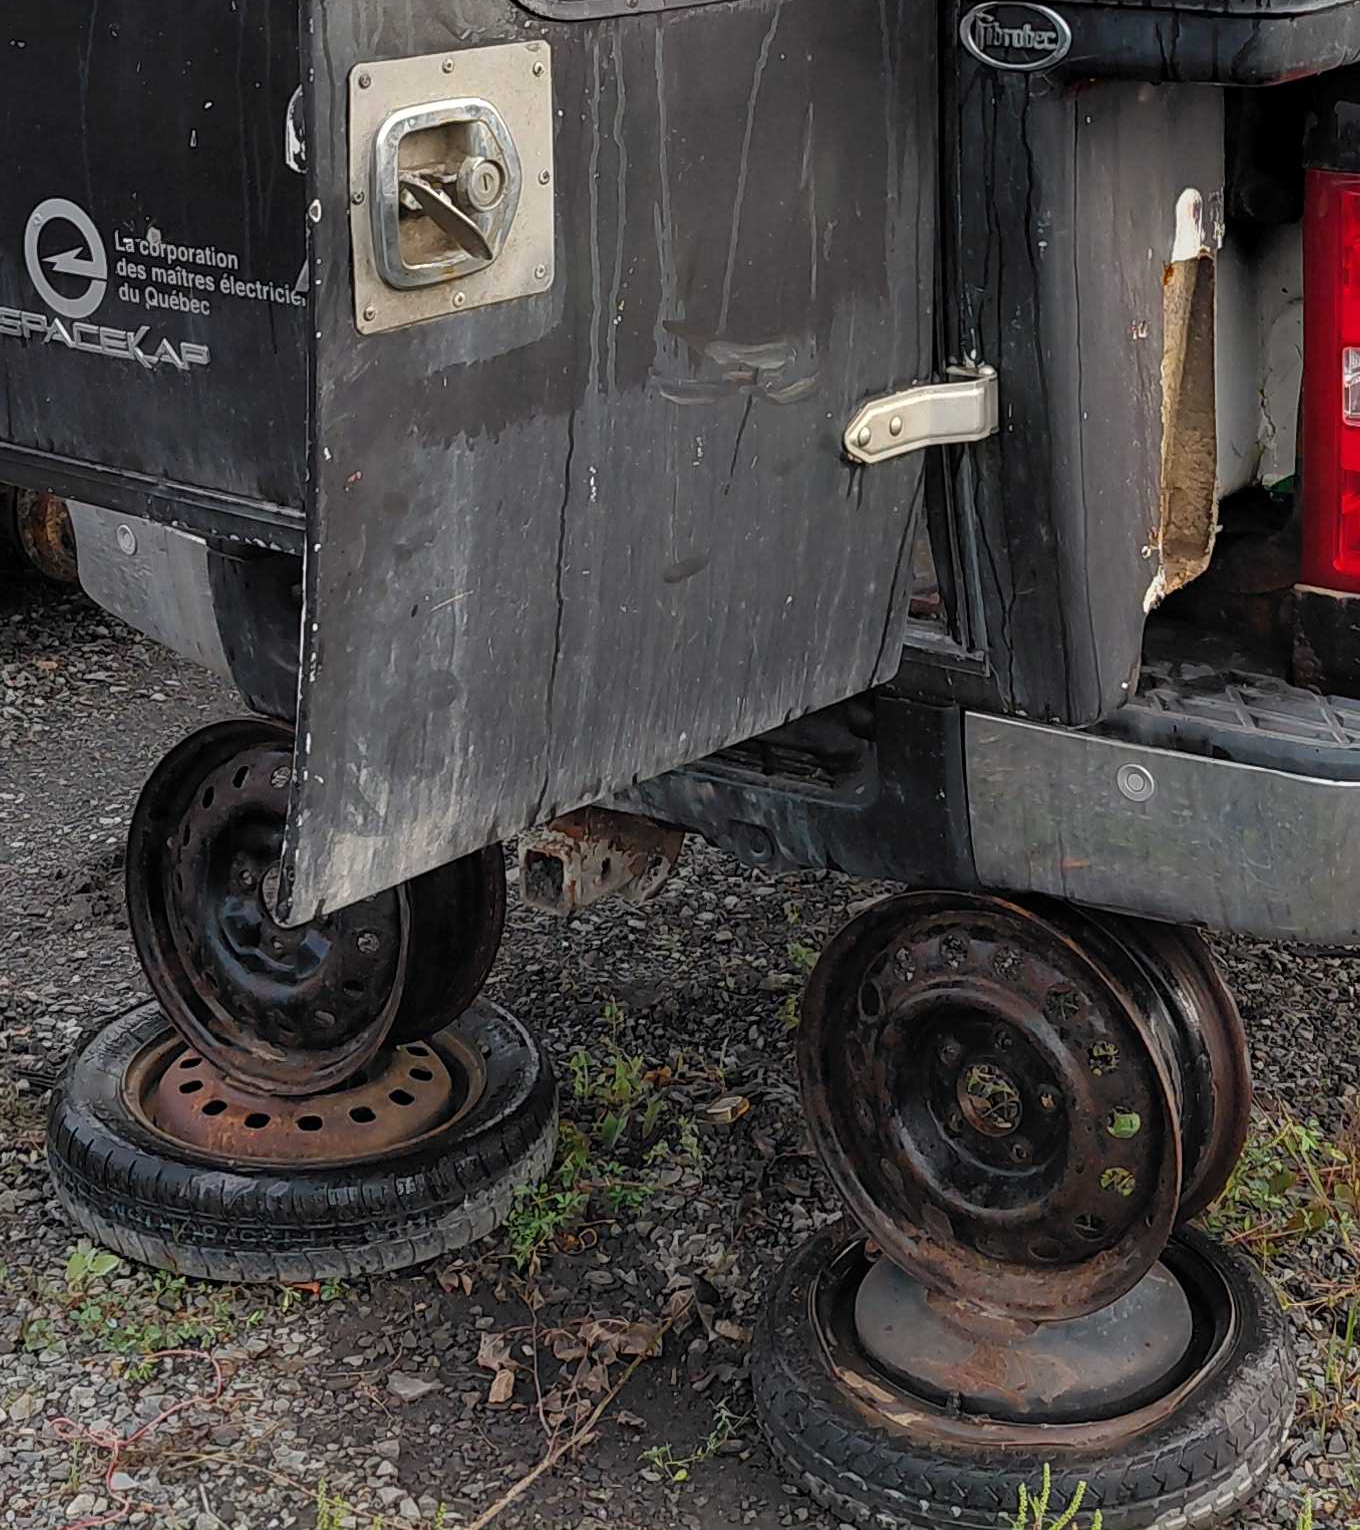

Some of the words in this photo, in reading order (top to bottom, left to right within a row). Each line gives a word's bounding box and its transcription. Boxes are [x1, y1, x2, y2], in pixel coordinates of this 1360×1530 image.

[114, 230, 135, 254] La
[139, 238, 239, 271] corporation
[116, 257, 147, 281] des
[151, 266, 216, 292] maîtres
[118, 282, 140, 304] du
[144, 286, 211, 316] Québec
